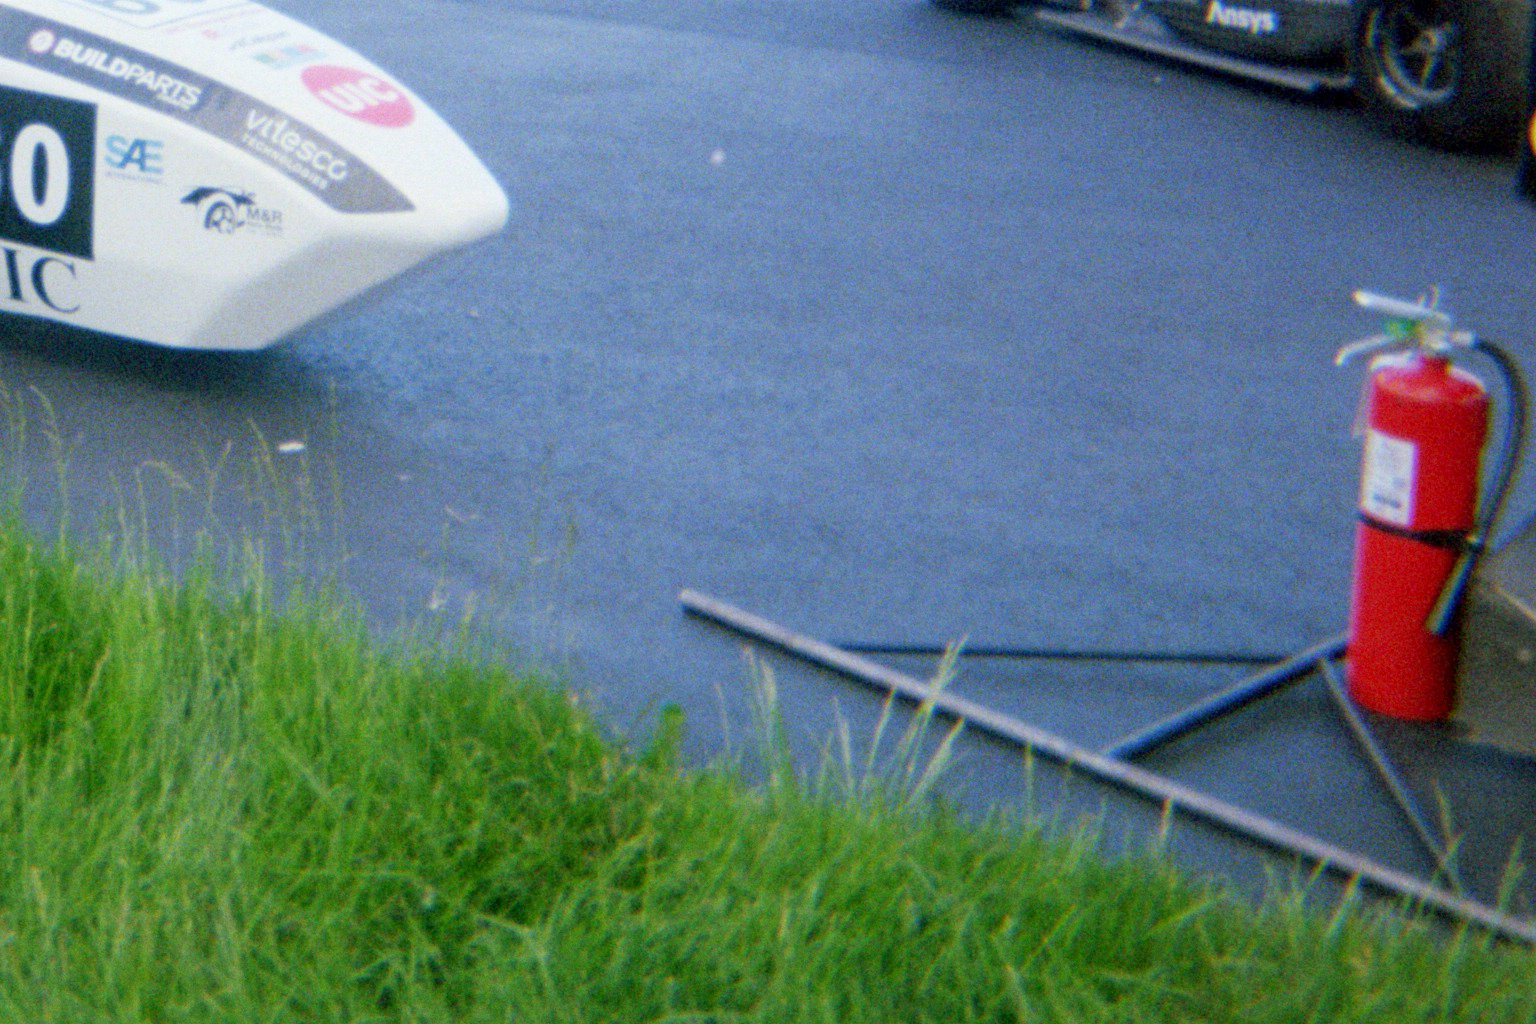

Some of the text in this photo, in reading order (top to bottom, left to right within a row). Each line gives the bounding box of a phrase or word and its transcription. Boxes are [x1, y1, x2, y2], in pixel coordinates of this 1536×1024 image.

[1206, 0, 1278, 35] Ansys
[53, 37, 202, 108] BUILDPARTS
[104, 133, 164, 174] SAE
